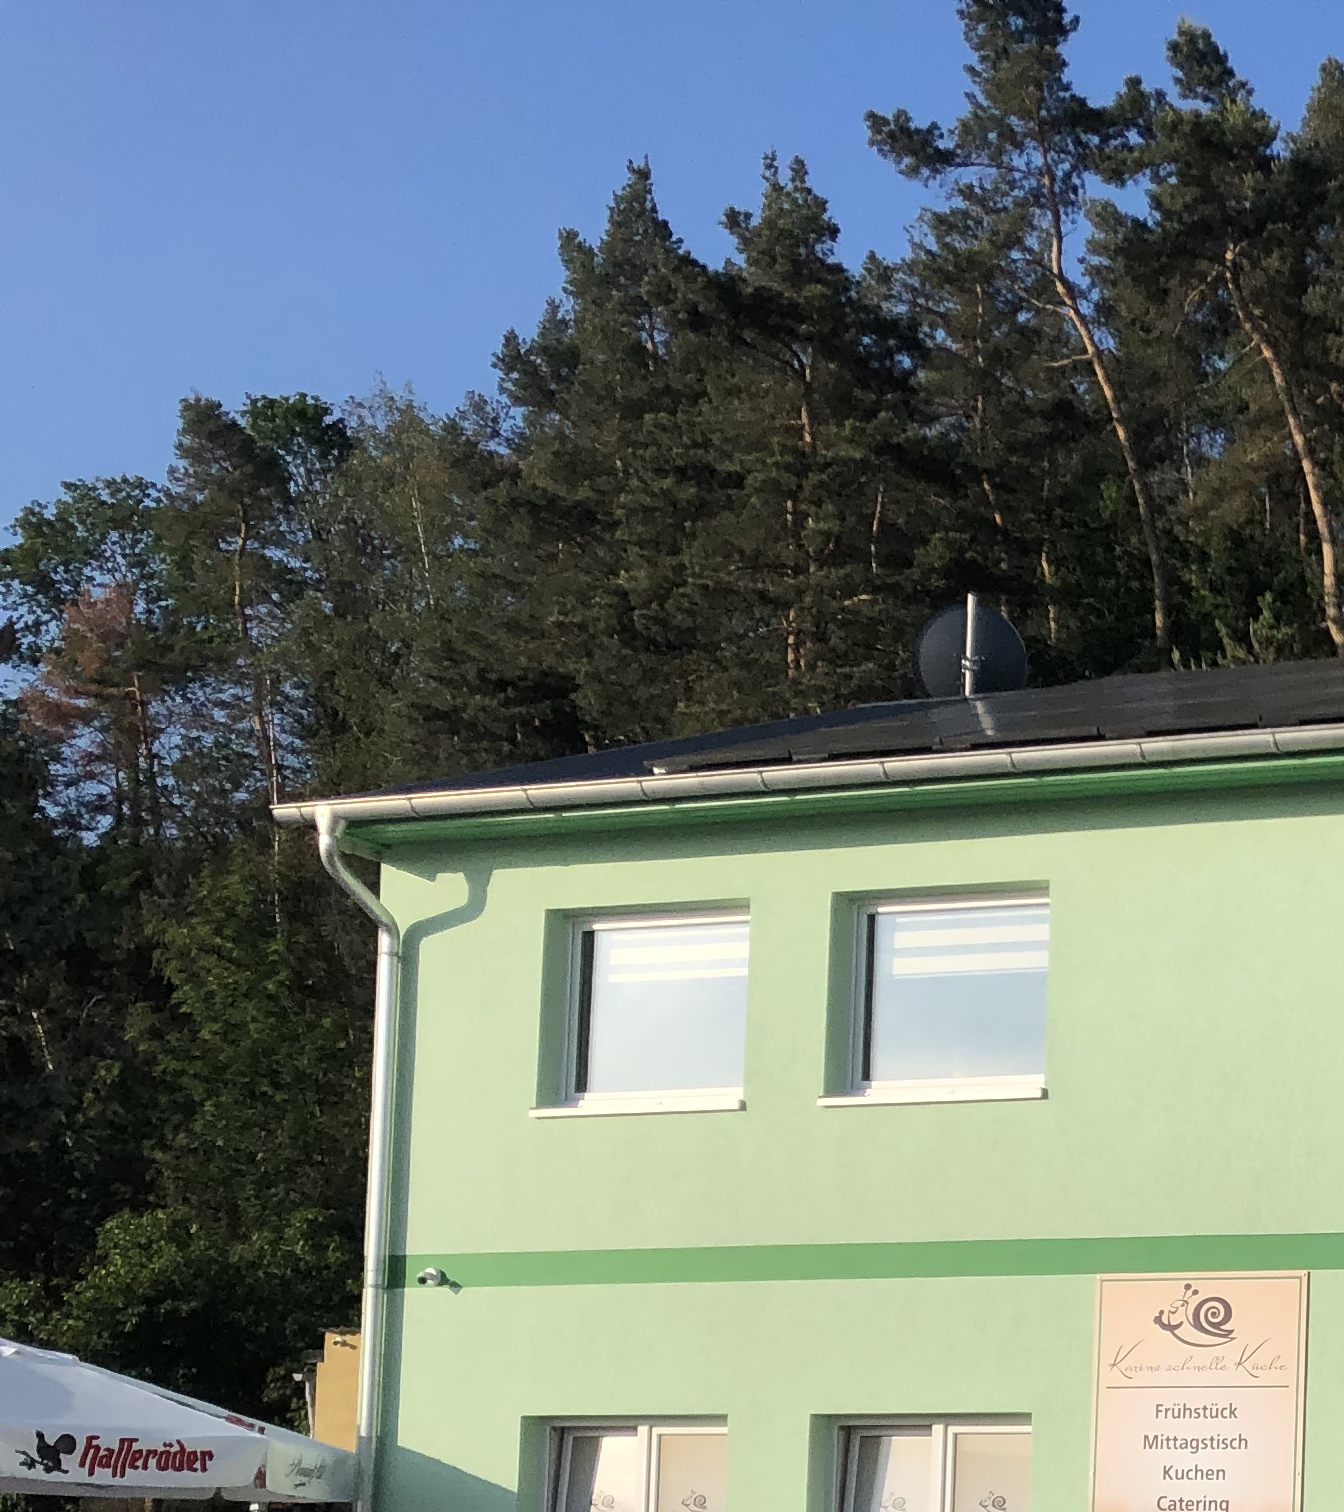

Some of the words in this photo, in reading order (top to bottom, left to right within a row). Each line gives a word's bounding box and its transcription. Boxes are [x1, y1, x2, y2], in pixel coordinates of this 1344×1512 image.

[1108, 1338, 1160, 1379] Karins
[1165, 1354, 1229, 1373] schnelle
[1233, 1337, 1288, 1379] Küche
[1155, 1402, 1239, 1420] Frühstück
[1142, 1433, 1248, 1454] Mittagstisch
[1162, 1463, 1226, 1481] Kuchen
